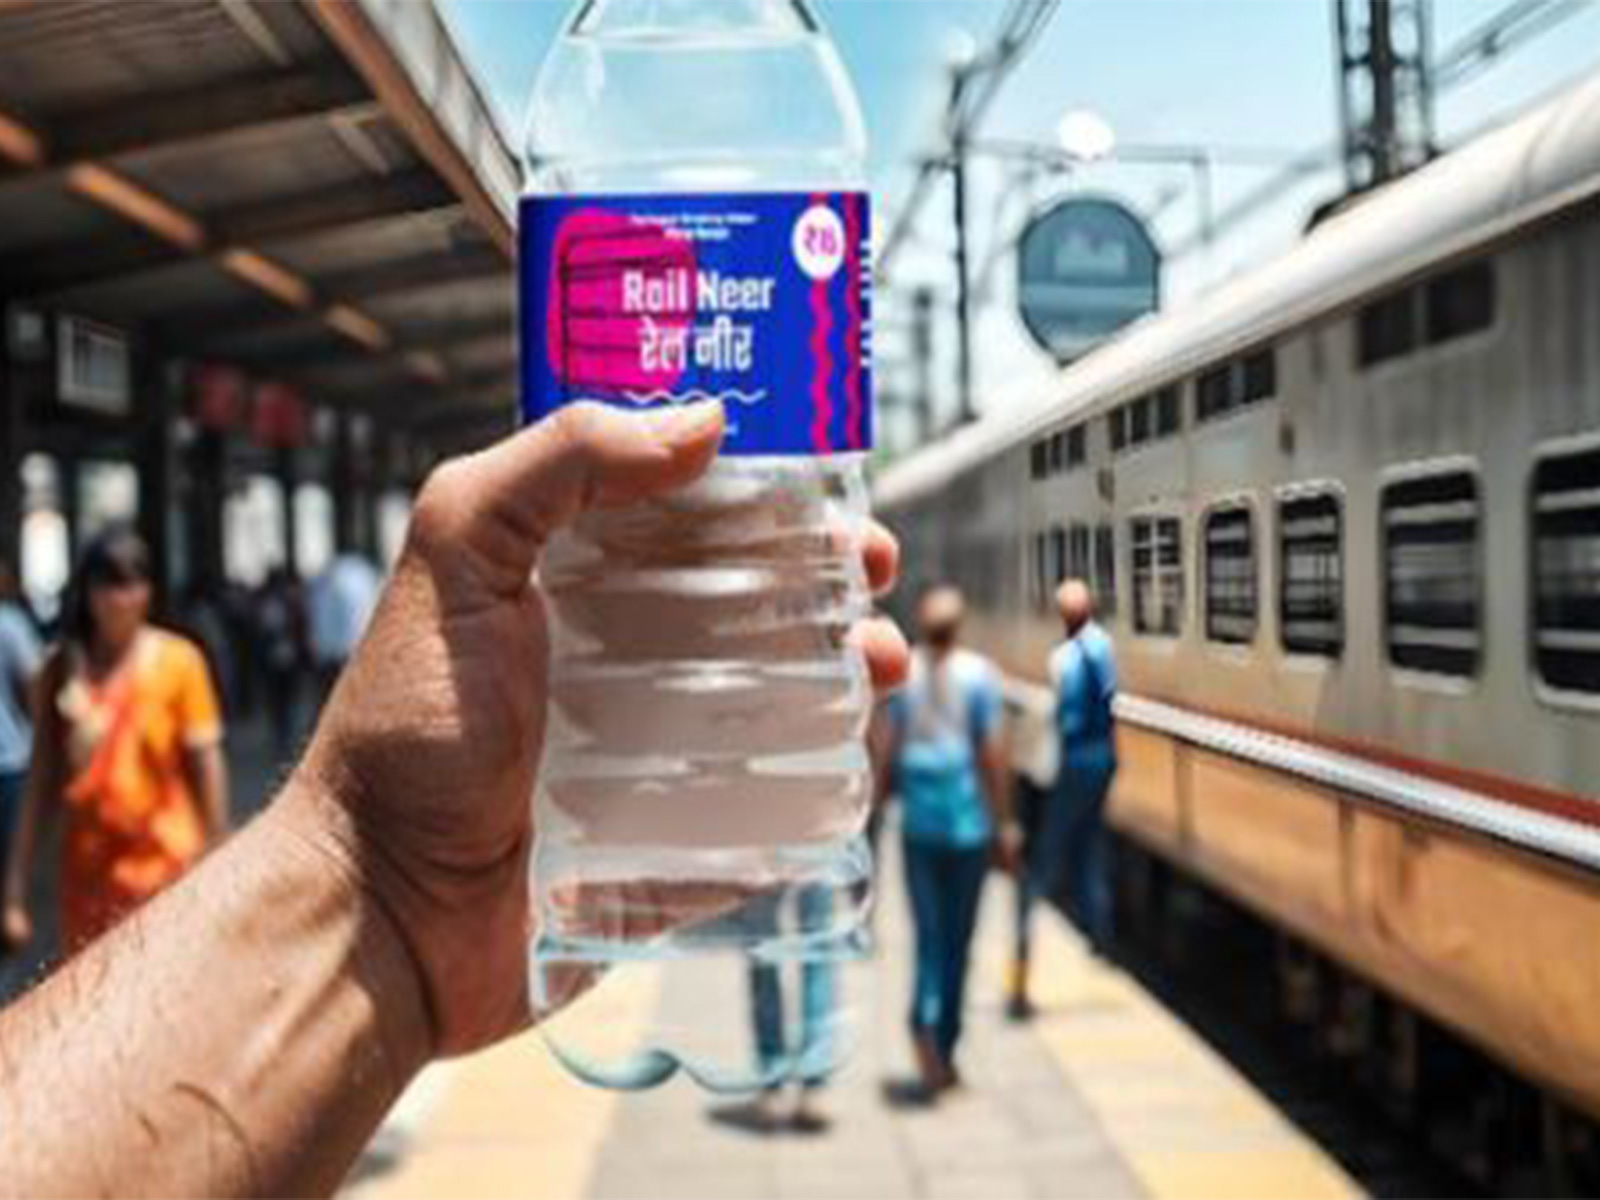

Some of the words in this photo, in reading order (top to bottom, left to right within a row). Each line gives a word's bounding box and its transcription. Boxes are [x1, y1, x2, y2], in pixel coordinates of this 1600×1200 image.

[623, 269, 688, 311] Rail
[697, 269, 775, 311] Neer
[637, 315, 688, 370] रेल
[694, 315, 753, 370] नीर
